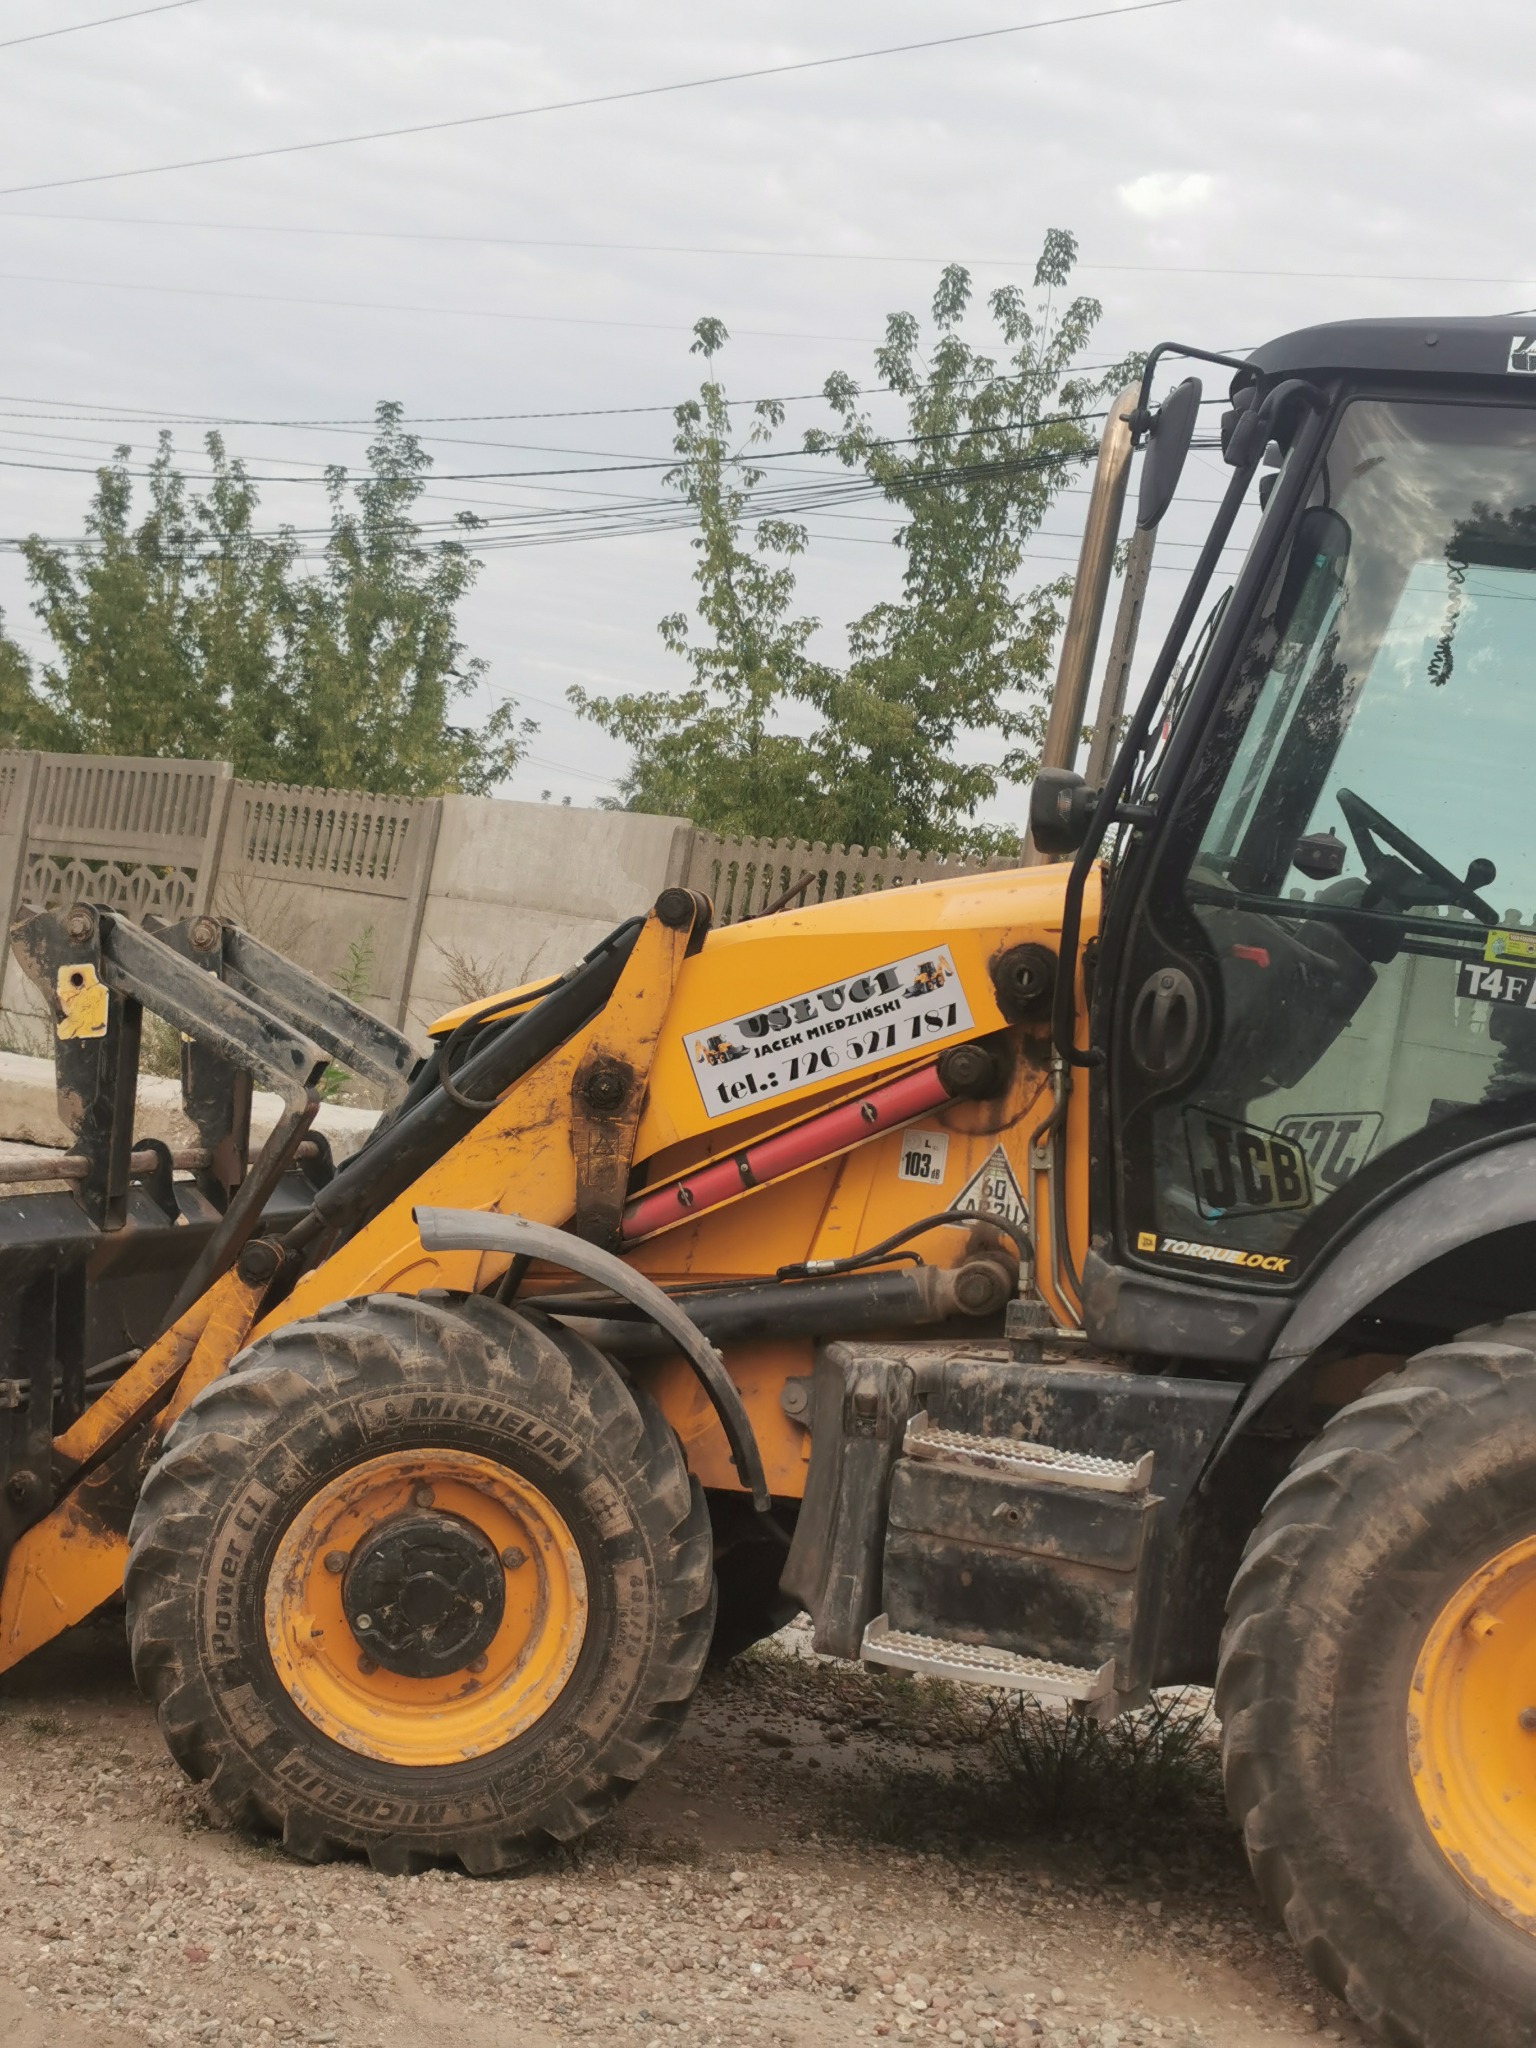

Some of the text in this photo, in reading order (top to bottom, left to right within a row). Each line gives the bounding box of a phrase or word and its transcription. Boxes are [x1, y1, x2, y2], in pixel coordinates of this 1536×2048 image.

[716, 1002, 957, 1104] tel.: 726 527 787
[753, 998, 902, 1058] JACEK MIEDZIŃSKI
[905, 1150, 932, 1178] 103
[1202, 1117, 1302, 1207] JCB
[1160, 1238, 1291, 1273] TORQUELOCK
[410, 1397, 576, 1462] MICHELIN
[211, 1495, 269, 1655] Power CL
[279, 1760, 447, 1825] MICHELIN
